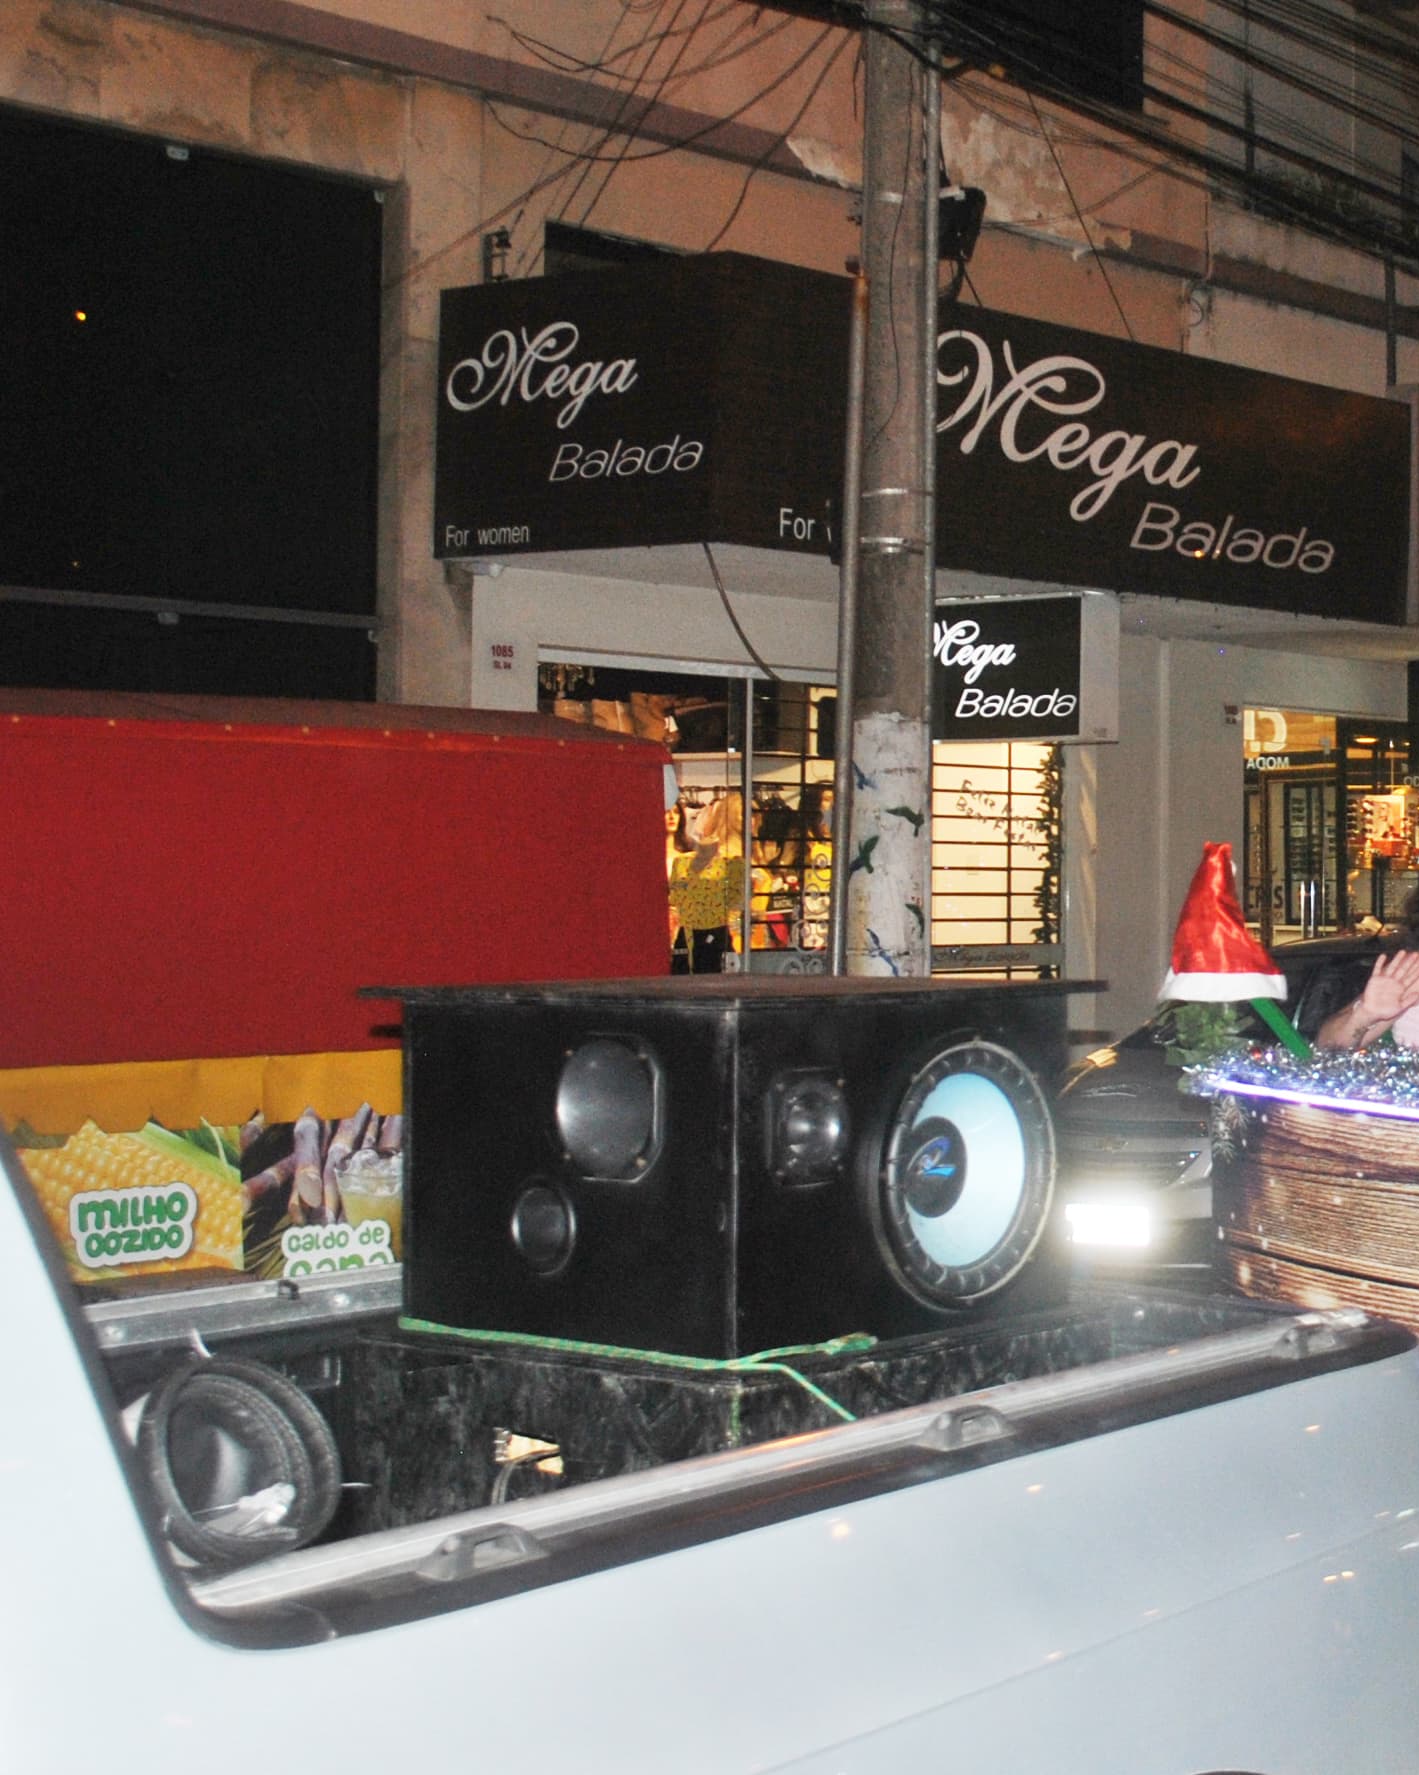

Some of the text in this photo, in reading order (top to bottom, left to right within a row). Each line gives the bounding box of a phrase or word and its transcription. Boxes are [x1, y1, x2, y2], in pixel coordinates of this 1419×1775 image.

[447, 321, 638, 429] Mega
[936, 330, 1201, 522] Mega
[549, 435, 703, 482] Balada
[446, 525, 529, 546] For women
[780, 507, 816, 540] For
[1130, 502, 1335, 573] Balada
[491, 644, 514, 658] 1085
[955, 687, 1077, 718] Balada
